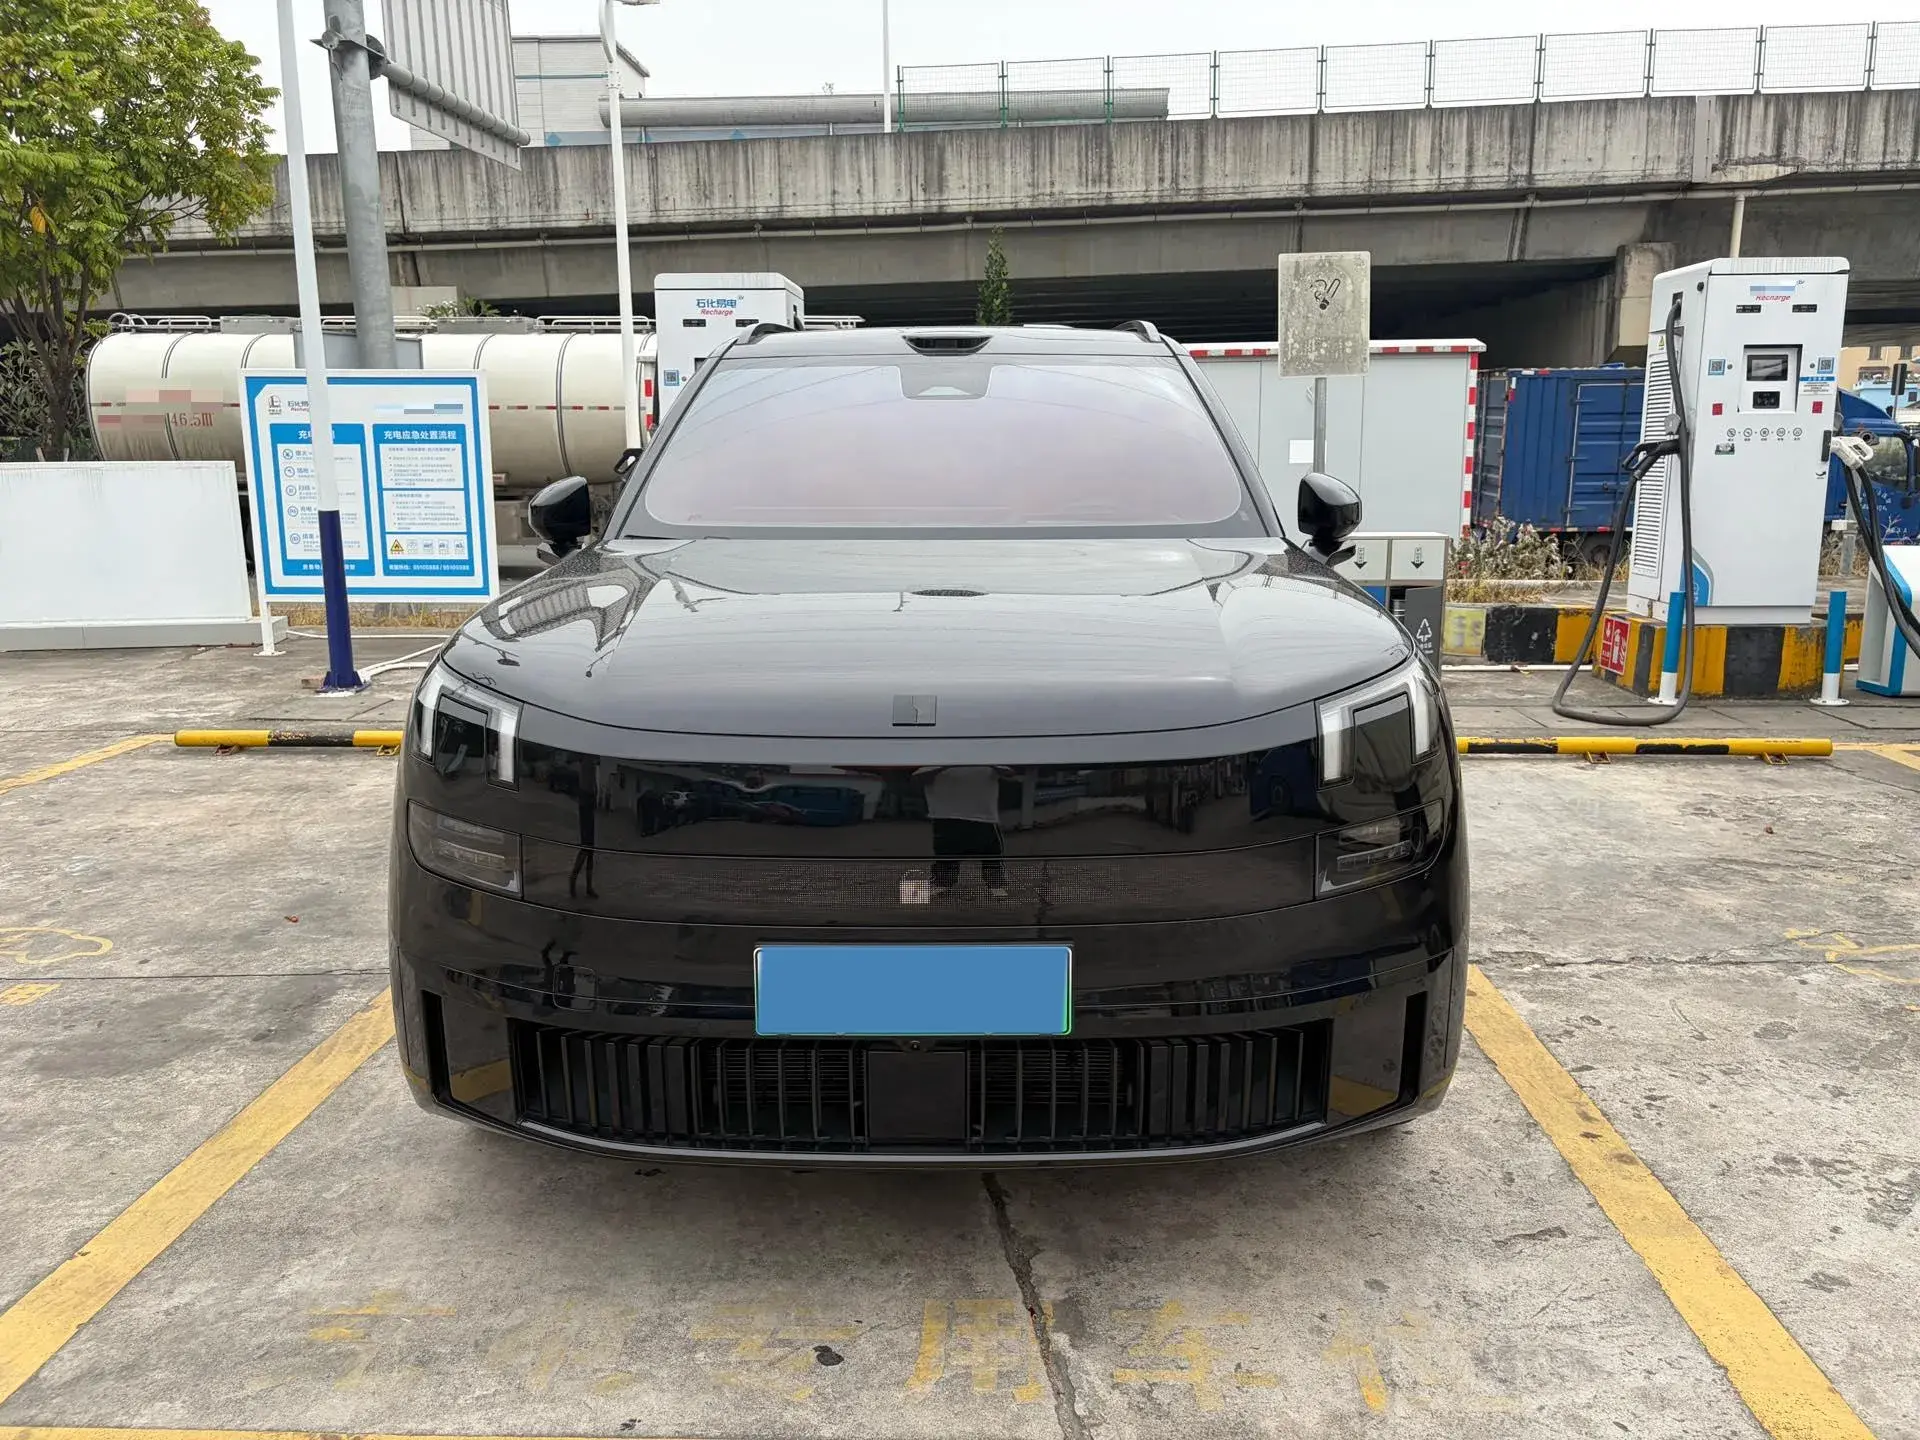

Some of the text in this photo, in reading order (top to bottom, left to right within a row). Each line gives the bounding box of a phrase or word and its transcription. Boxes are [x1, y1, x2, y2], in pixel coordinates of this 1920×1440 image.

[1755, 294, 1791, 302] Recharge
[696, 298, 737, 308] 石化易电
[701, 308, 733, 316] Recharge
[384, 430, 457, 440] 充电应急处置流程
